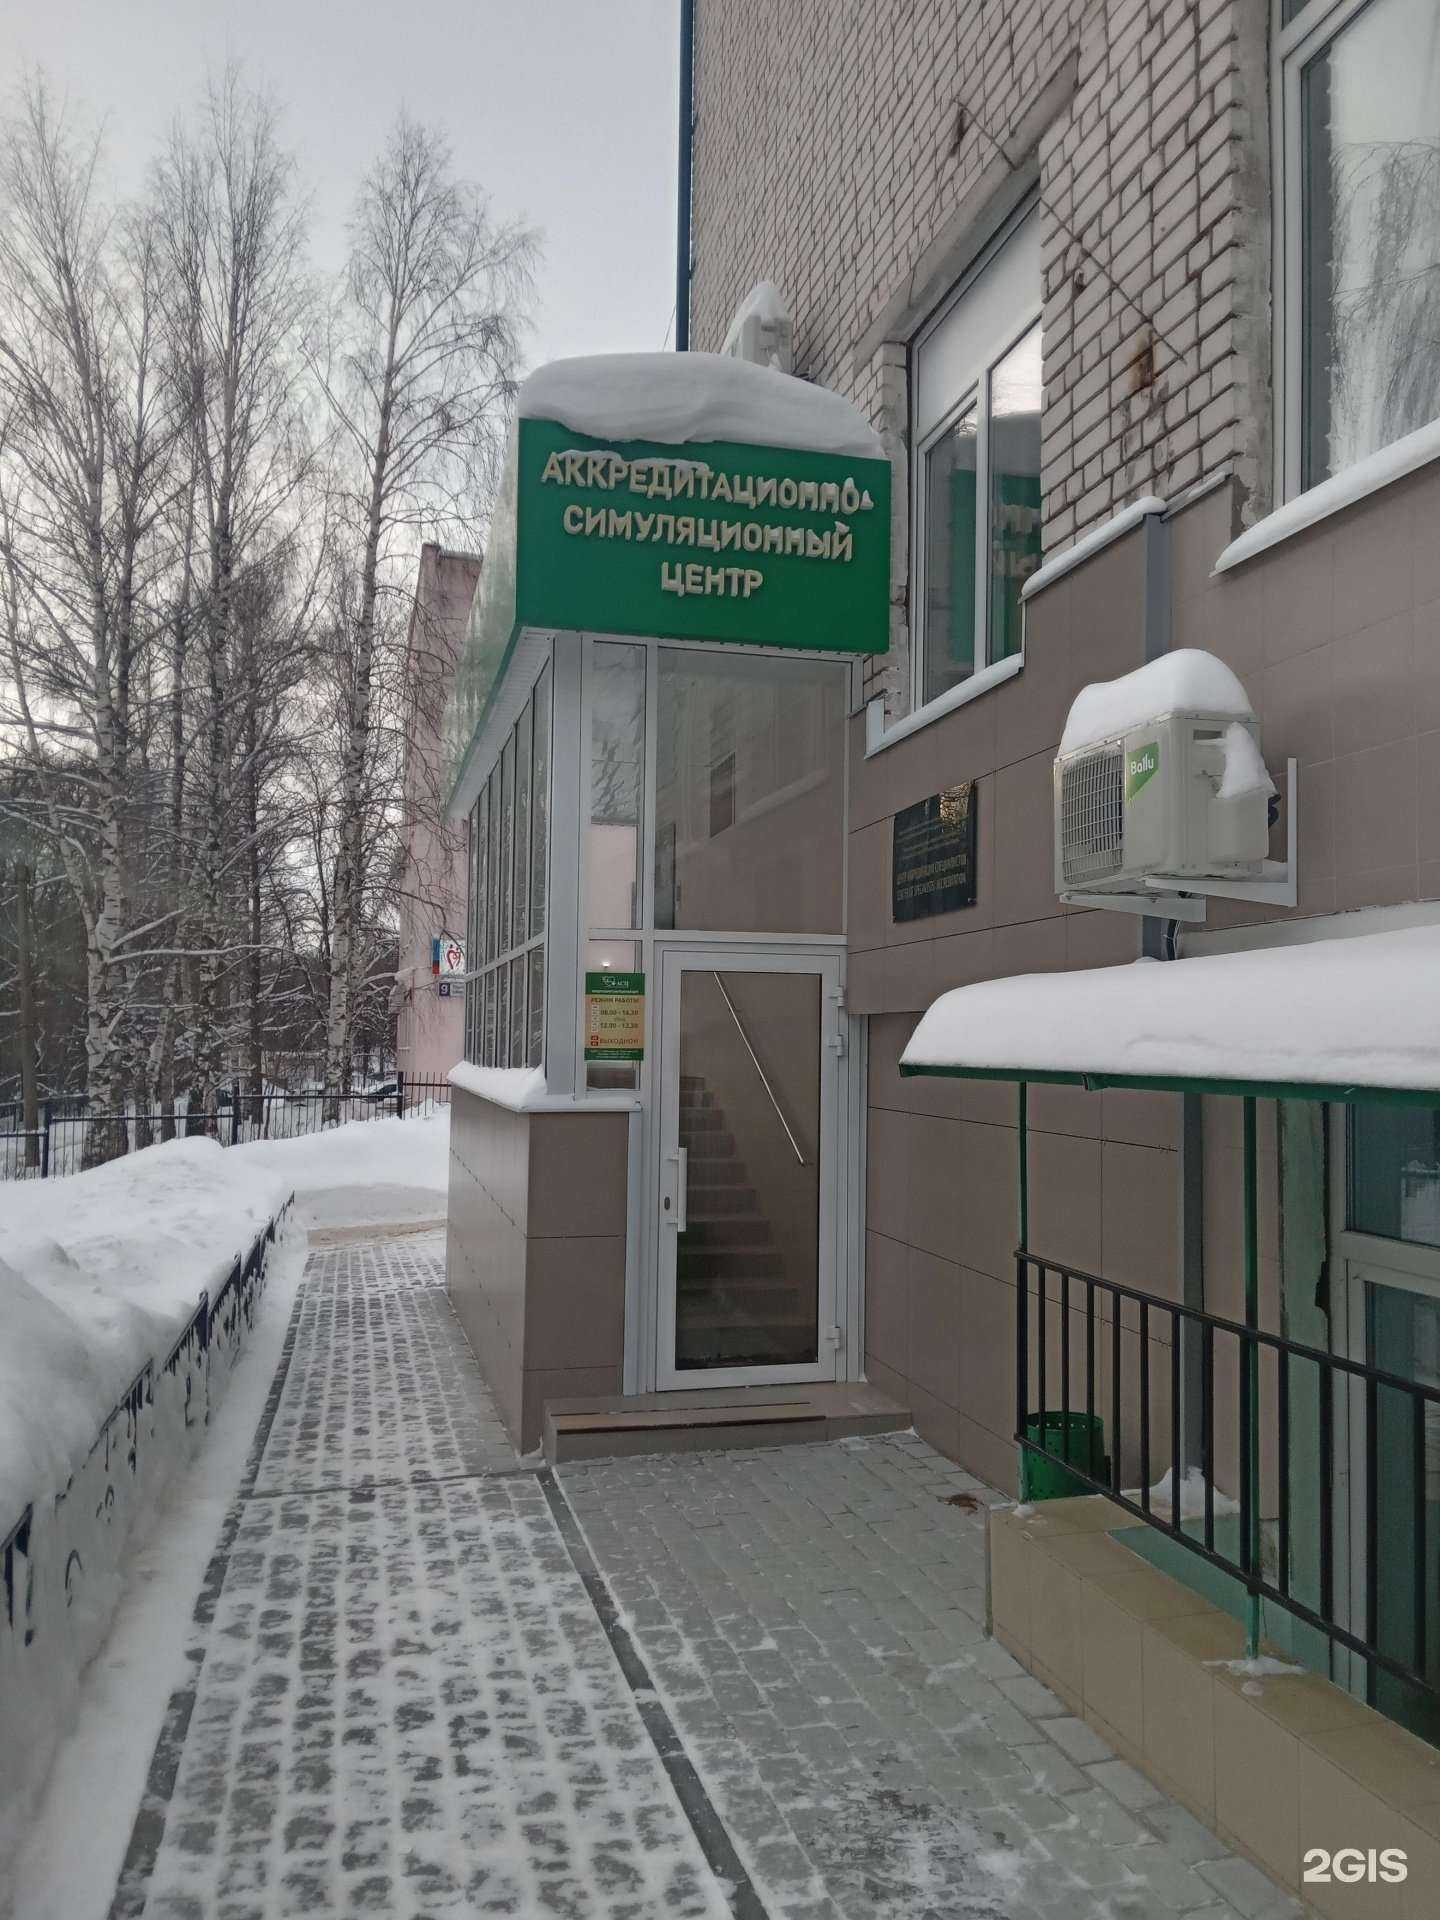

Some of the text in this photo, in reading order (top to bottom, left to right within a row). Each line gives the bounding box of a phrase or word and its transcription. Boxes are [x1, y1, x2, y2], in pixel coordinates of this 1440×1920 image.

[563, 504, 853, 562] СИМУЛЯЦИОННЫЙ
[661, 561, 764, 598] ЦЕНТР
[1131, 752, 1154, 775] Ballu
